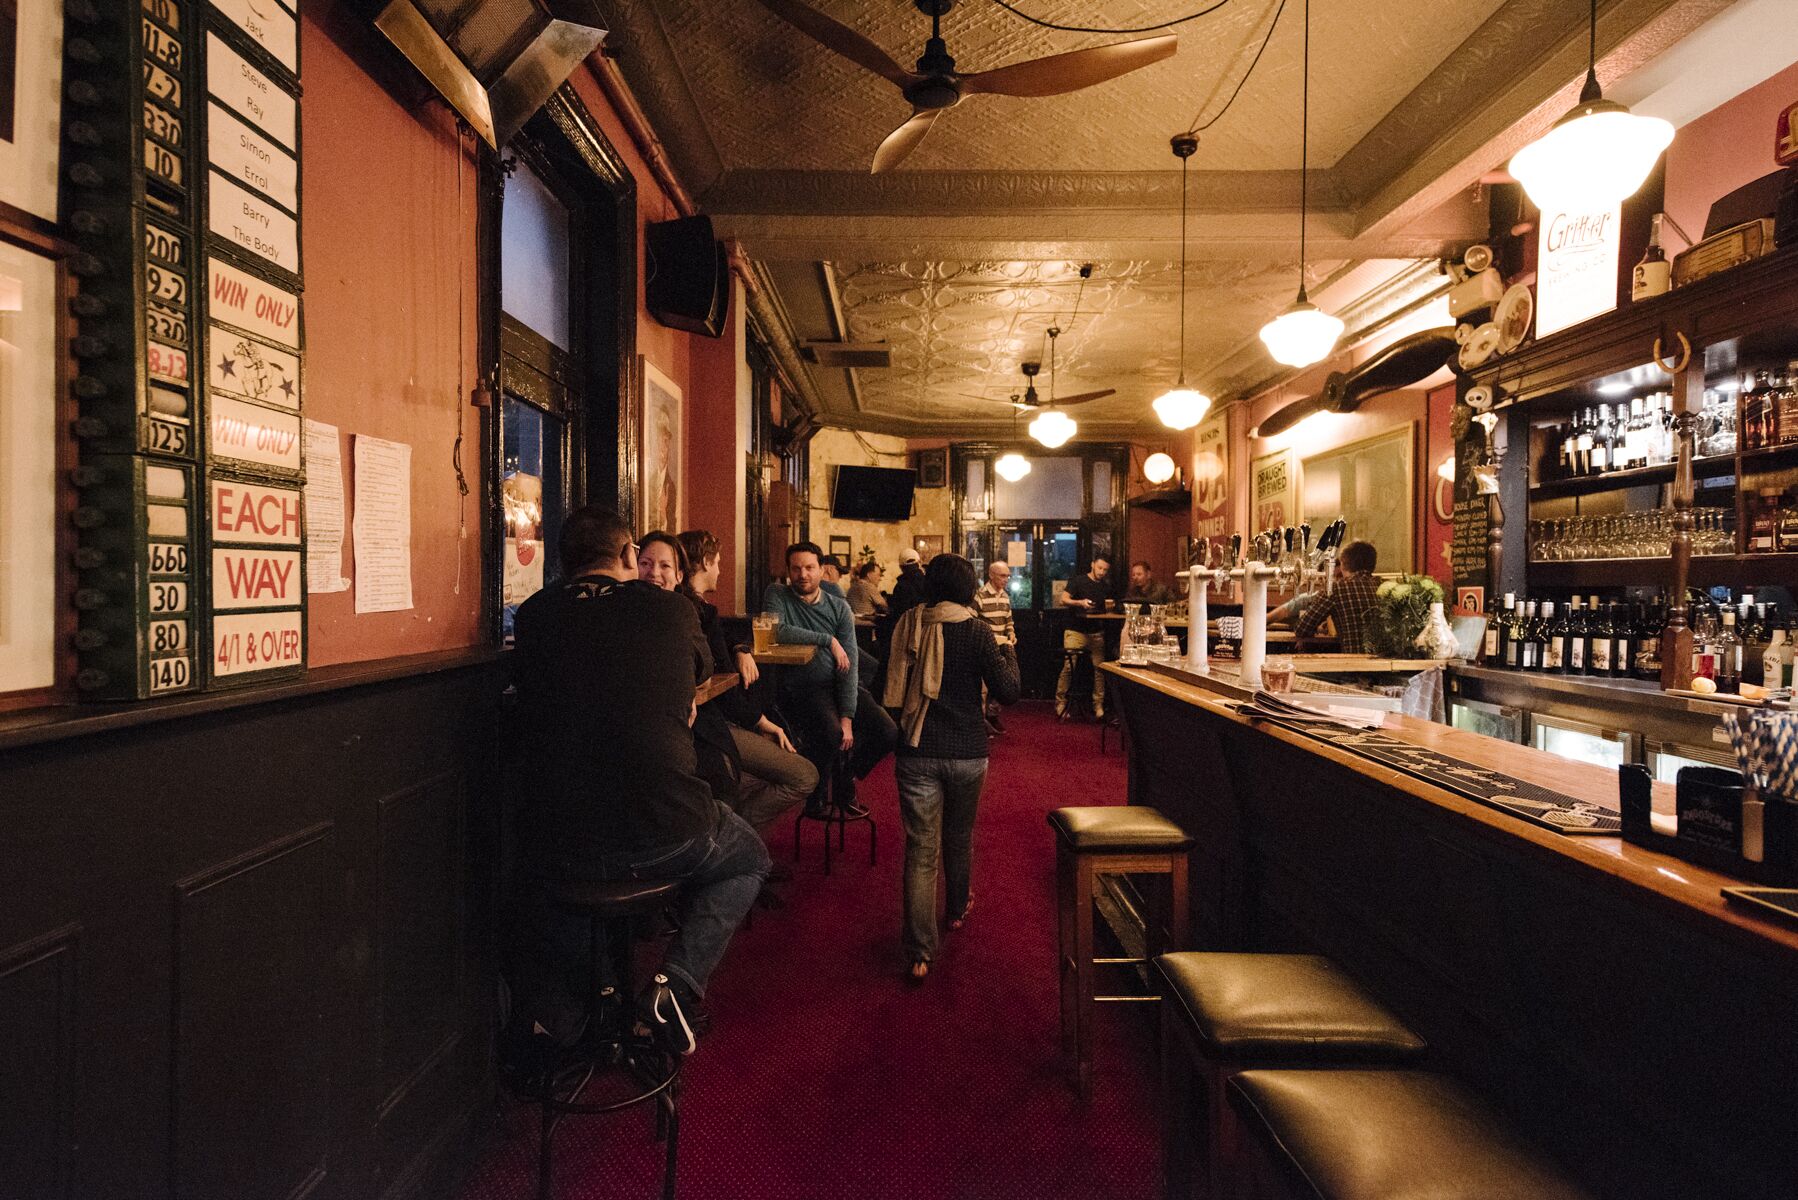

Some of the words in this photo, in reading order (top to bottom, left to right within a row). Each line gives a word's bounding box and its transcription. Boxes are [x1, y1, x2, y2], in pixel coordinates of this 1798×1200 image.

[245, 16, 264, 41] Jack
[241, 64, 268, 94] Steve
[247, 96, 264, 120] Ray
[154, 147, 173, 178] 10
[240, 134, 271, 164] Simon
[244, 165, 268, 190] Errol
[243, 202, 270, 228] Barry
[233, 225, 252, 245] The
[254, 237, 280, 261] Body
[214, 273, 248, 311] WIN
[255, 294, 295, 328] ONLY
[152, 422, 185, 453] 125
[216, 414, 249, 447] WIN
[257, 425, 295, 456] ONLY
[1258, 463, 1287, 486] DRAUGHT
[1258, 477, 1287, 499] BREWED
[217, 487, 300, 538] EACH
[1199, 516, 1225, 539] DINNER
[151, 546, 187, 572] 660
[225, 557, 293, 599] WAY
[153, 585, 179, 611] 30
[155, 624, 180, 650] 80
[218, 633, 240, 671] 4/1
[246, 632, 257, 664] &
[261, 630, 299, 662] OVER
[151, 660, 186, 689] 140
